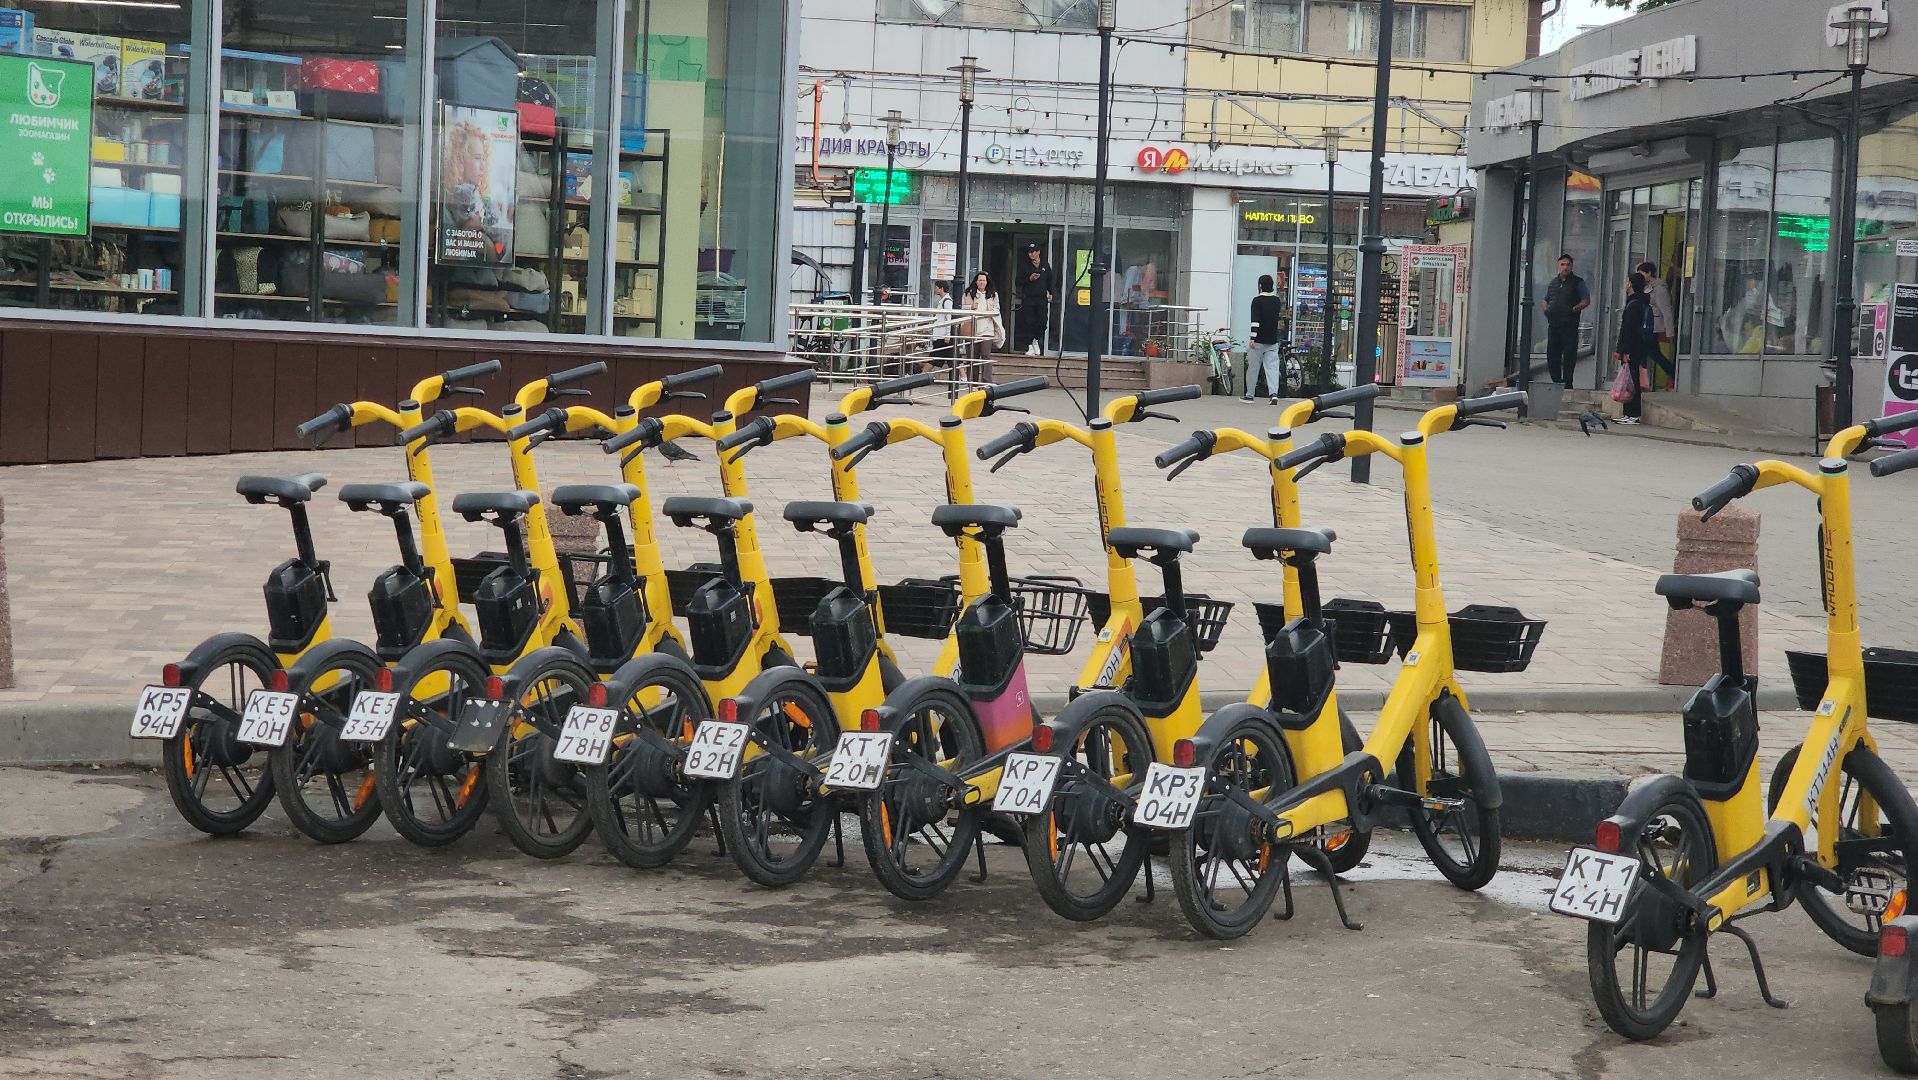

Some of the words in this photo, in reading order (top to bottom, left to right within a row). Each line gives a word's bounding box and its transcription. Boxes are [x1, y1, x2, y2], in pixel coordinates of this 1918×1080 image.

[10, 113, 80, 130] ЛЮБИМЧИК
[18, 128, 71, 140] ЗООМАГАЗИН
[857, 138, 931, 158] КРАОТЫ
[32, 196, 53, 209] МЫ
[4, 211, 78, 230] ОТКРЫЛИСЬ!
[1245, 211, 1285, 222] НАПИТКИ
[445, 239, 457, 247] ВАС
[457, 239, 463, 247] И
[463, 240, 484, 248] ВАШИХ
[451, 229, 477, 238] ЗАБОТОЙ
[478, 231, 483, 239] О
[445, 249, 477, 258] ЛЮБИМЫХ
[1824, 547, 1837, 617] WHOOSH
[143, 691, 186, 713] KP5
[249, 694, 294, 716] KE5
[354, 696, 394, 715] KE5
[139, 714, 177, 735] 94H
[242, 718, 285, 741] 70H
[346, 719, 389, 737] 35H
[568, 711, 613, 733] KP8
[560, 735, 606, 759] 78H
[696, 725, 743, 748] KE2
[840, 737, 889, 759] KT1
[689, 750, 735, 774] 82H
[1006, 759, 1056, 782] KP7
[1149, 771, 1200, 799] KP3
[999, 785, 1042, 809] 70A
[1143, 799, 1192, 825] 04H
[1569, 854, 1635, 886] KT1
[1560, 885, 1623, 916] 44H
